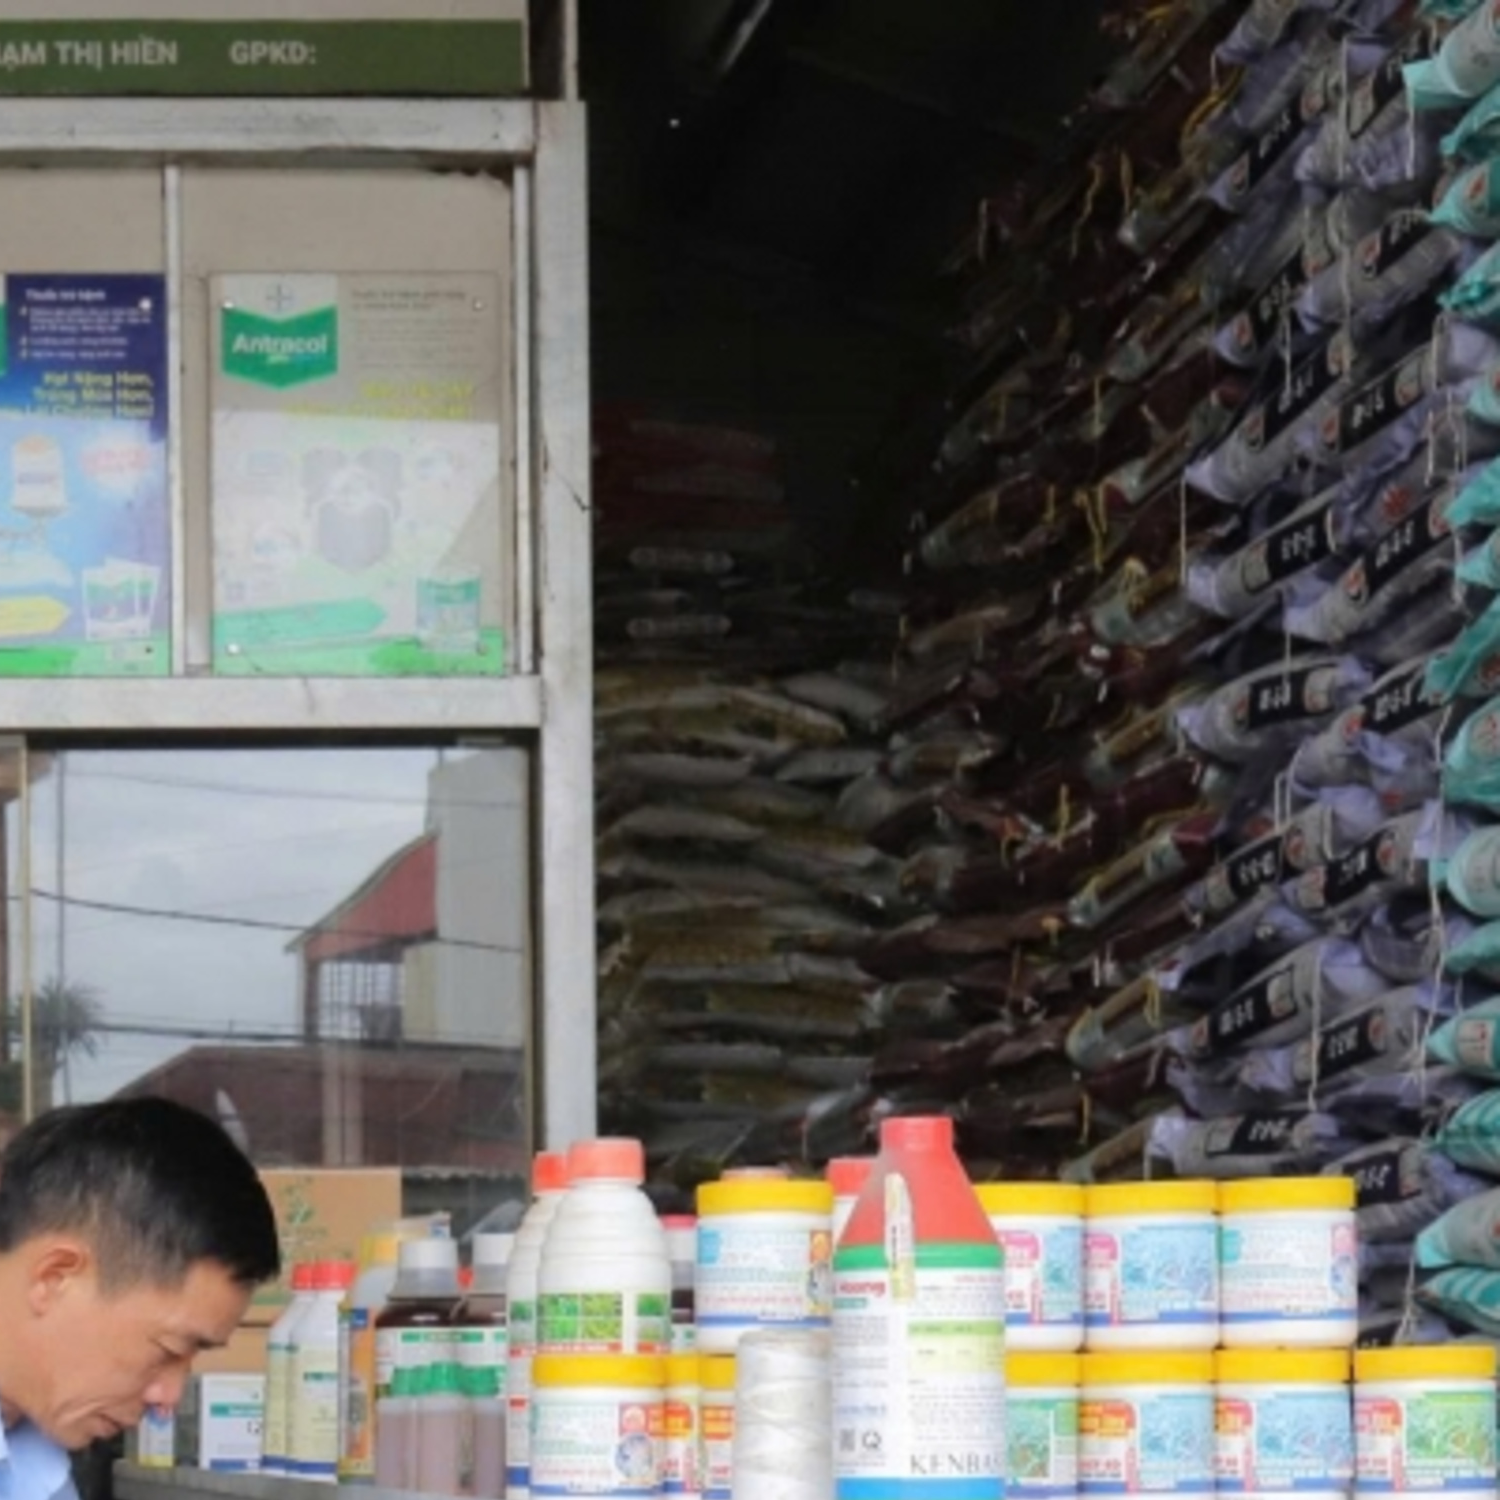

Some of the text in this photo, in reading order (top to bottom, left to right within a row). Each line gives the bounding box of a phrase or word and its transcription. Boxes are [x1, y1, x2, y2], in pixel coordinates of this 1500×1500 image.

[55, 40, 102, 70] THỊ
[111, 34, 178, 65] HIỀN
[229, 40, 317, 65] GPKD:
[232, 334, 328, 355] Antracol
